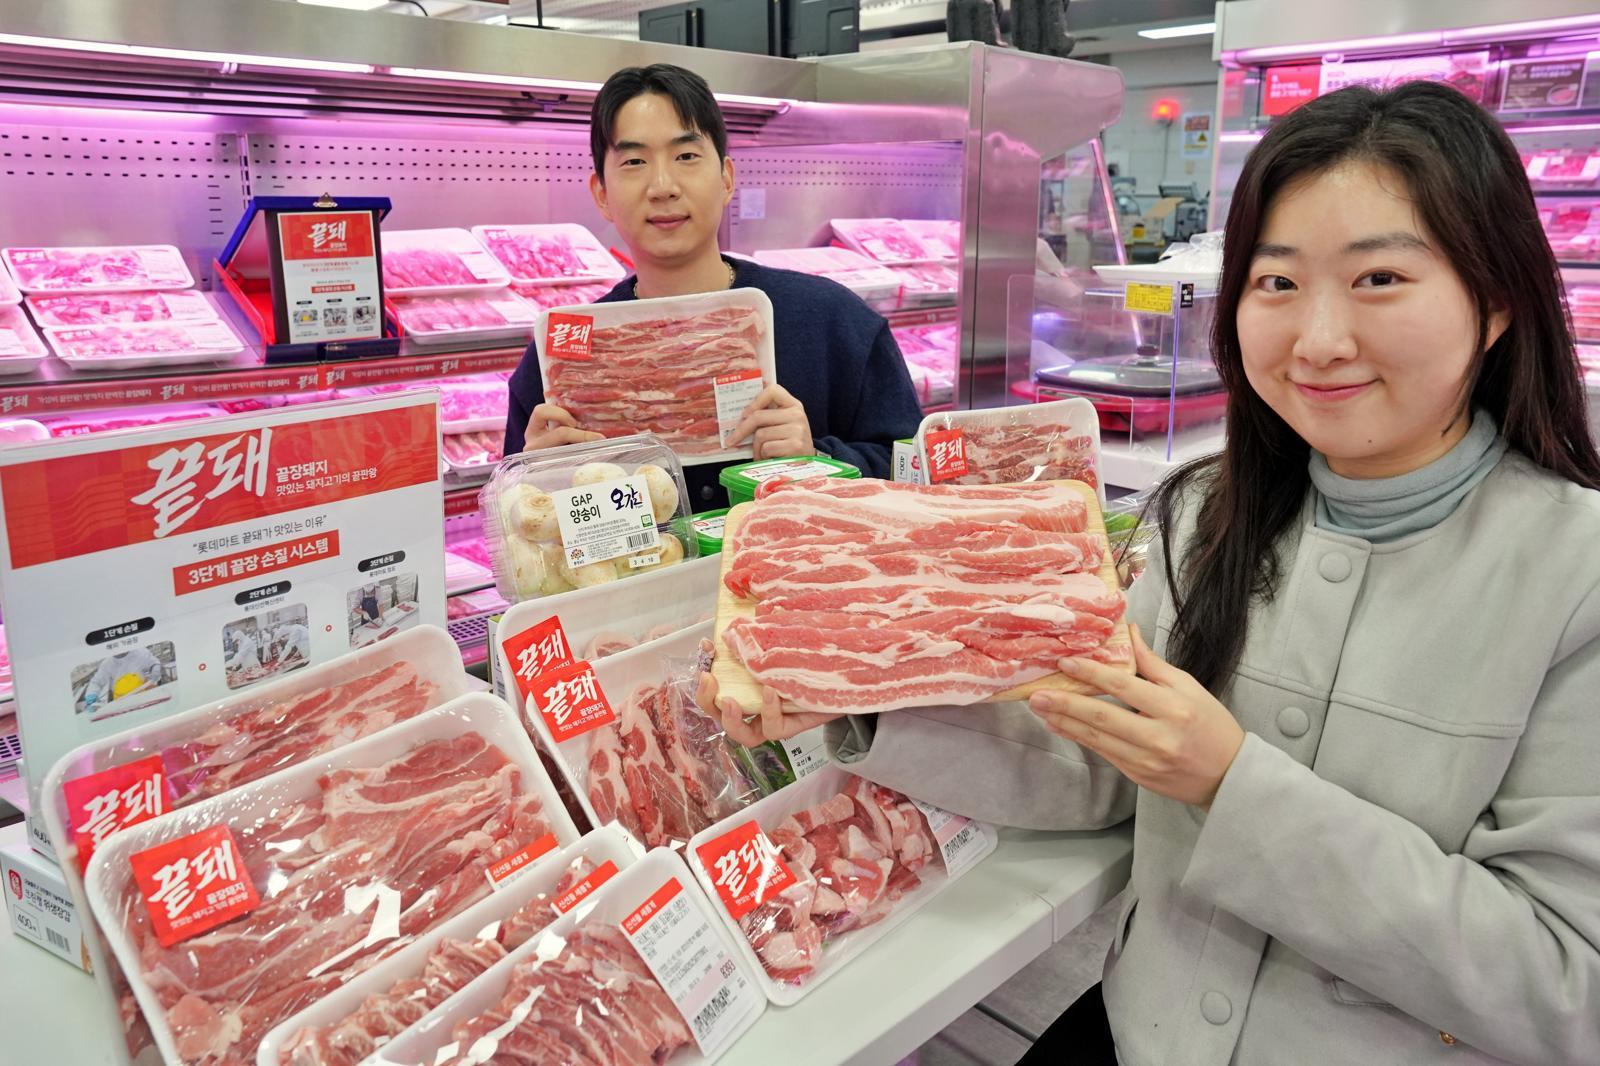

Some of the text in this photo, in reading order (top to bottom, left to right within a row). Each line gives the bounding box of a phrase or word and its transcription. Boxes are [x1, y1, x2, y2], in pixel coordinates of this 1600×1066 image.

[308, 221, 347, 248] 끝돼
[549, 323, 592, 347] 끝돼
[297, 369, 318, 389] 끝돼
[325, 368, 346, 385] 끝돼
[440, 360, 459, 373] 끝돼
[1, 394, 28, 412] 끝돼
[160, 383, 185, 400] 끝돼
[930, 437, 962, 470] 끝돼
[130, 427, 273, 538] 끝돼
[275, 459, 328, 484] 끝장돼지
[276, 467, 378, 497] 맛있는 돼지고기의 끝판왕
[571, 493, 593, 507] GAP
[569, 505, 601, 524] 양송이
[242, 529, 272, 546] 끝돼가
[273, 521, 303, 539] 맛있는
[188, 537, 329, 586] 3단계 끝장 손질 시스템
[515, 628, 566, 682] 끝돼
[542, 669, 598, 725] 끝돼
[76, 773, 162, 851] 끝돼
[714, 833, 767, 899] 끝돼
[147, 839, 237, 919] 끝돼
[205, 882, 246, 906] 끝장돼지
